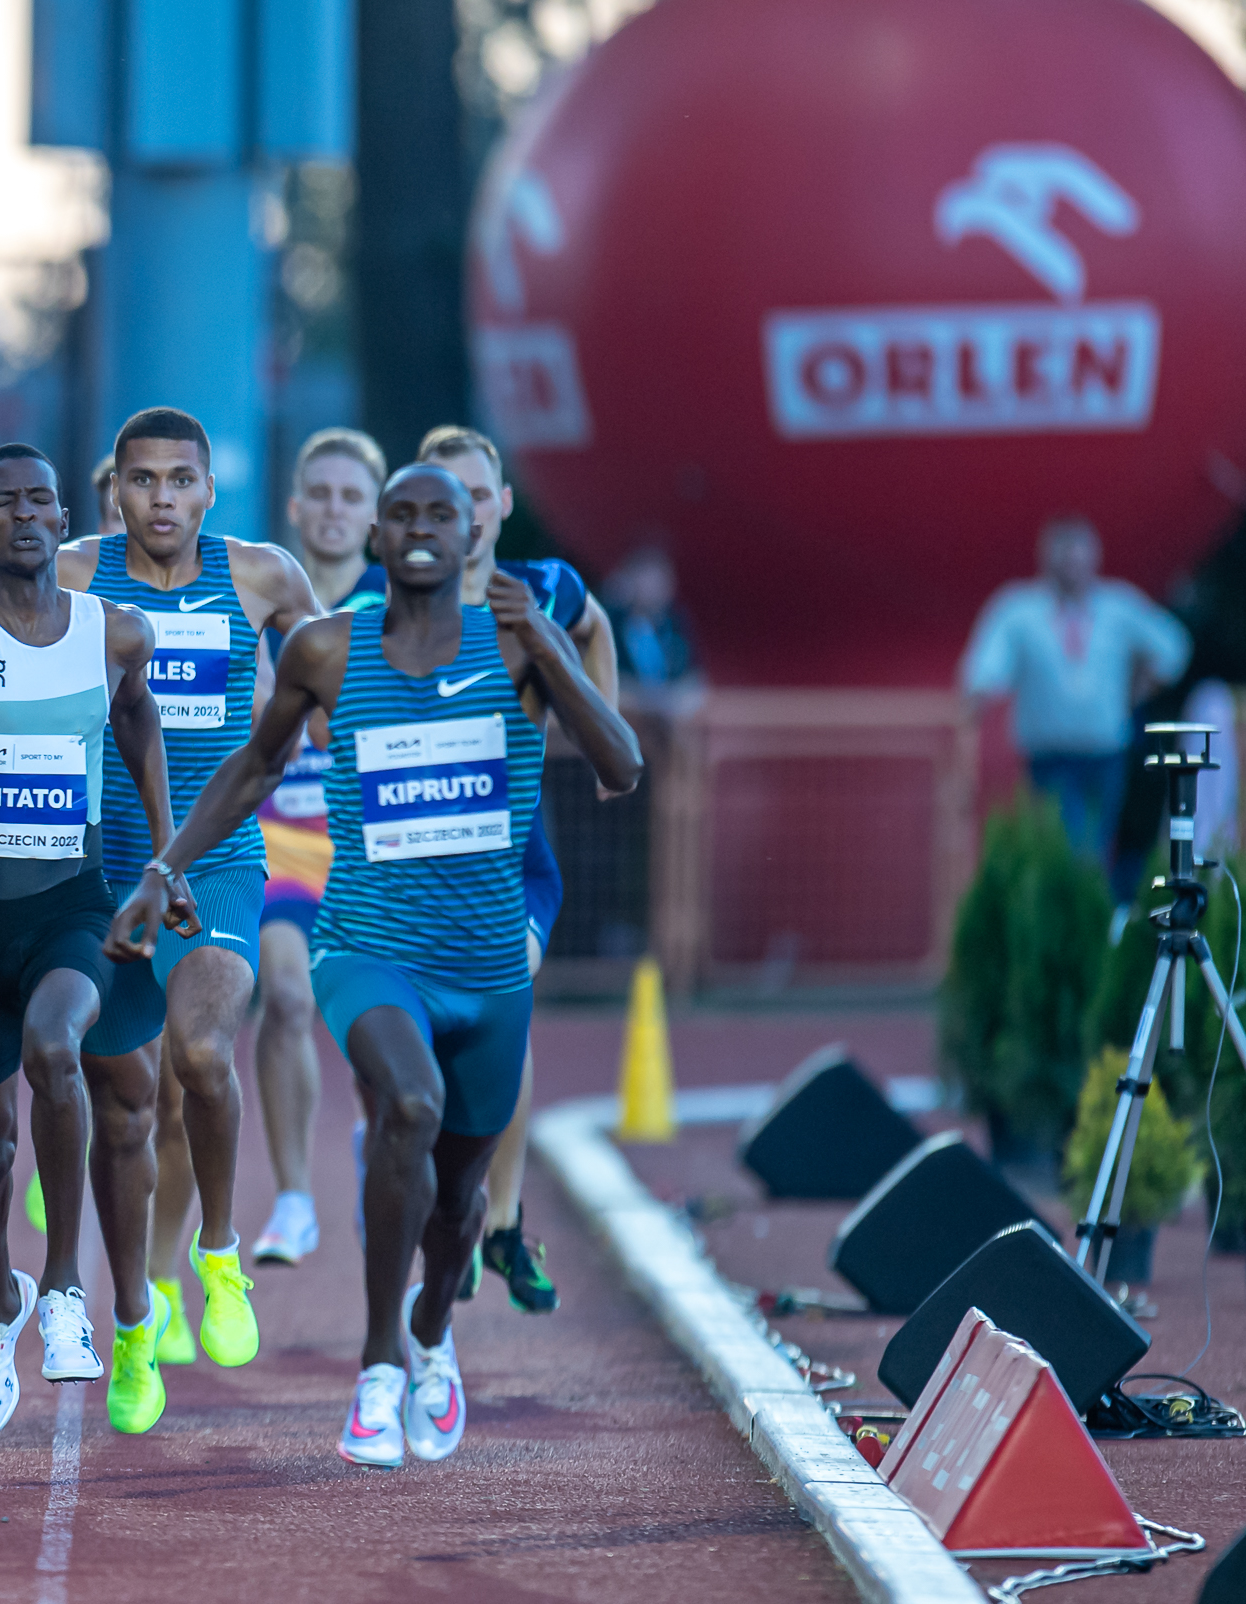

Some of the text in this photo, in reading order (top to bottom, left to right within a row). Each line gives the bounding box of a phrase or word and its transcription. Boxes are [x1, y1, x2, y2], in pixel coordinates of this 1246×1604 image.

[799, 340, 1132, 408] ORLEN
[146, 660, 197, 682] ILES
[160, 704, 220, 717] ECIN 2022
[377, 773, 494, 807] KIPRUTO
[50, 835, 79, 847] 2022
[406, 828, 473, 844] SZCZECIN
